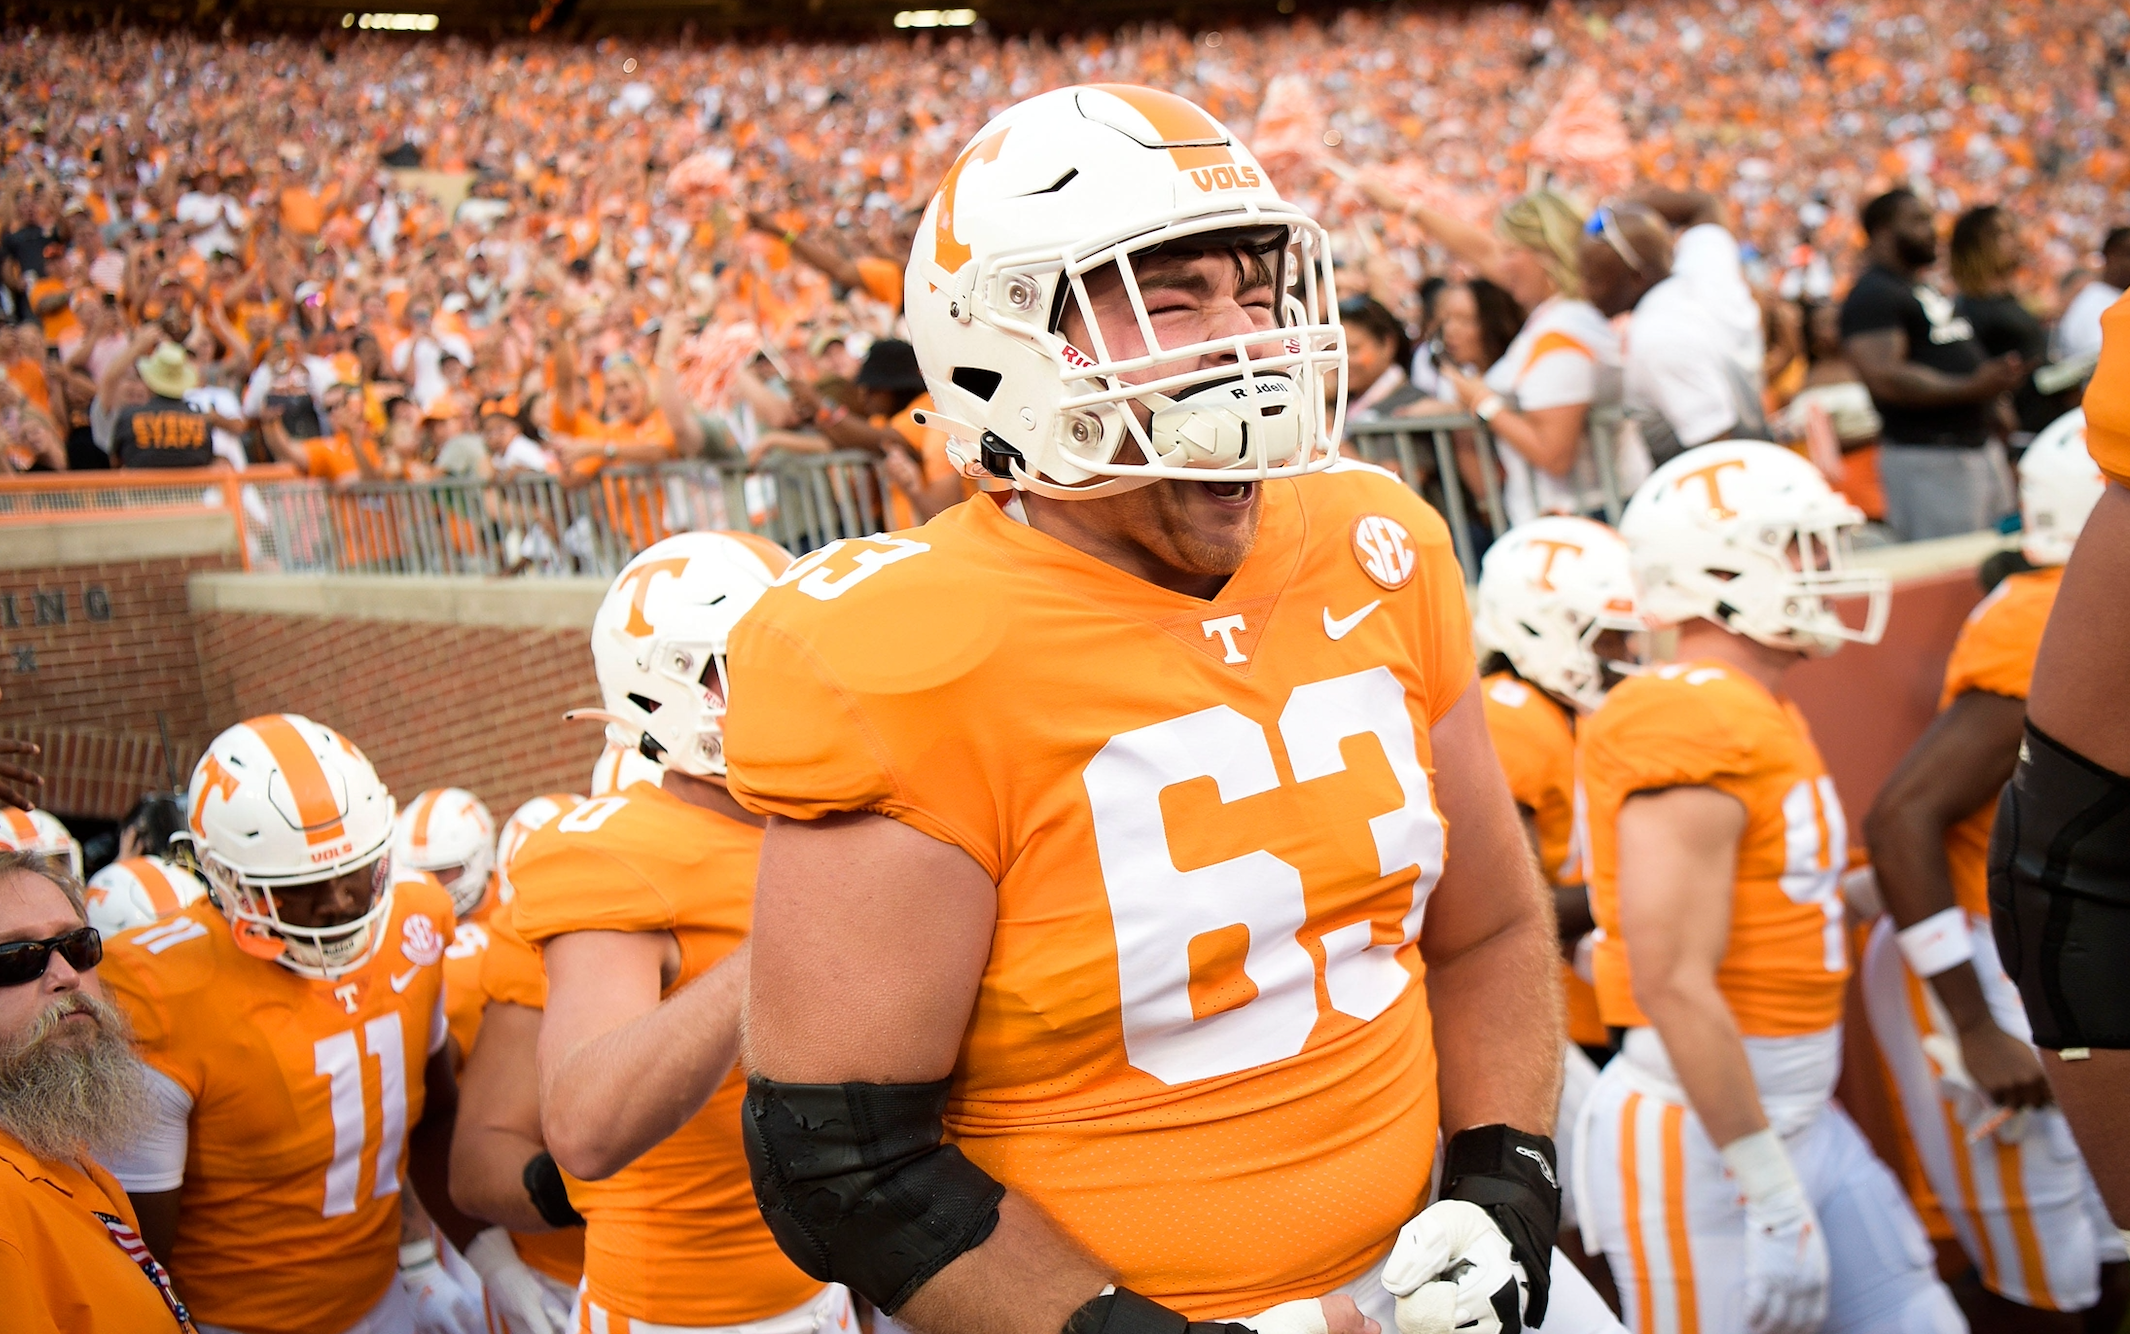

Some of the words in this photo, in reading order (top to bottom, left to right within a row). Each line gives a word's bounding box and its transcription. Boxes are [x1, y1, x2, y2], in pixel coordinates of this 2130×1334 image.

[1190, 166, 1260, 192] VOLS
[1230, 383, 1288, 399] Rddell
[1675, 460, 1746, 520] T
[1356, 515, 1414, 585] SEC
[1529, 539, 1583, 591] T
[617, 557, 690, 637] T
[1202, 613, 1247, 664] T
[1082, 666, 1444, 1086] 63
[131, 916, 208, 955] 11
[334, 982, 359, 1014] T
[314, 1010, 408, 1218] 11
